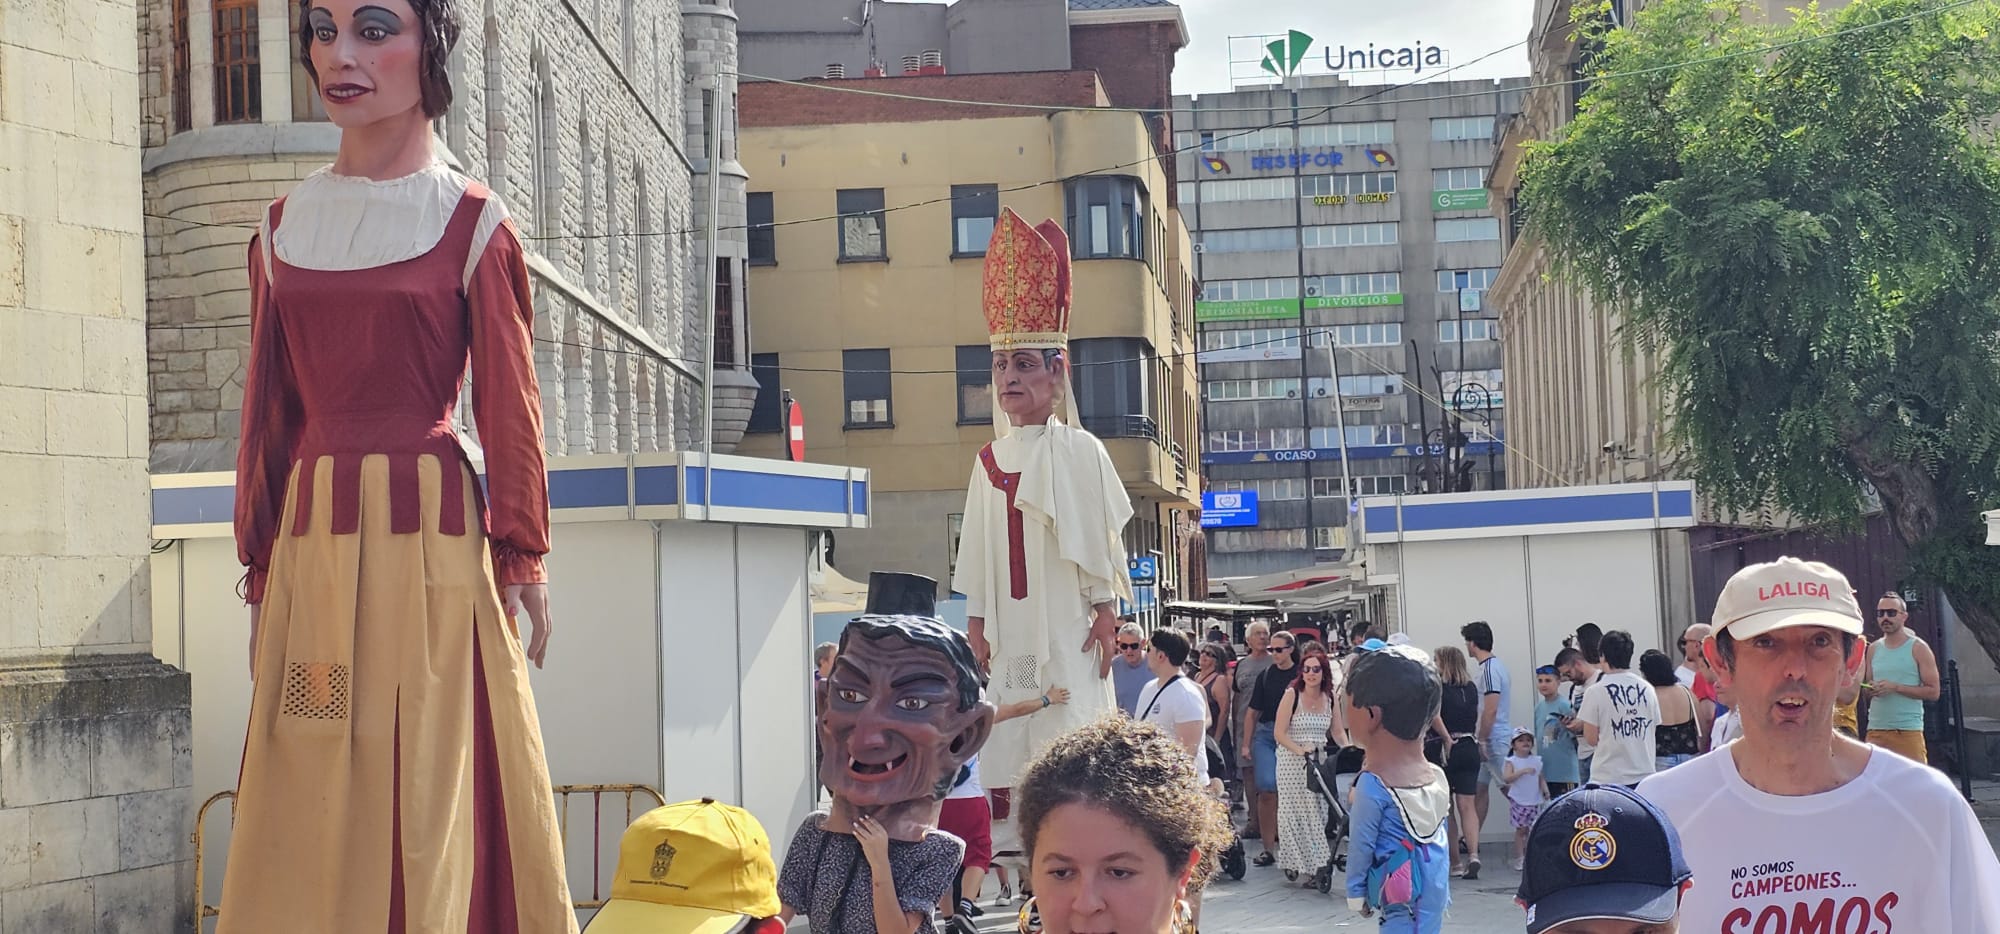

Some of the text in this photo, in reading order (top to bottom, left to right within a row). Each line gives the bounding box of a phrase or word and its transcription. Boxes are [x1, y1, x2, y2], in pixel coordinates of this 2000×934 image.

[1324, 40, 1441, 74] Unicaja
[1314, 193, 1389, 206] OXFORD IDIOMAS
[1318, 295, 1389, 307] DIVORCIOS
[1274, 450, 1316, 461] OCASO
[1758, 581, 1830, 601] LALIGA
[1605, 683, 1647, 713] RICK
[1626, 708, 1638, 716] AND
[1611, 717, 1653, 740] MORTY
[1731, 861, 1794, 880] NO SOMOS
[1731, 871, 1857, 899] CAMPEONES...
[1721, 891, 1899, 934] SOMOS
